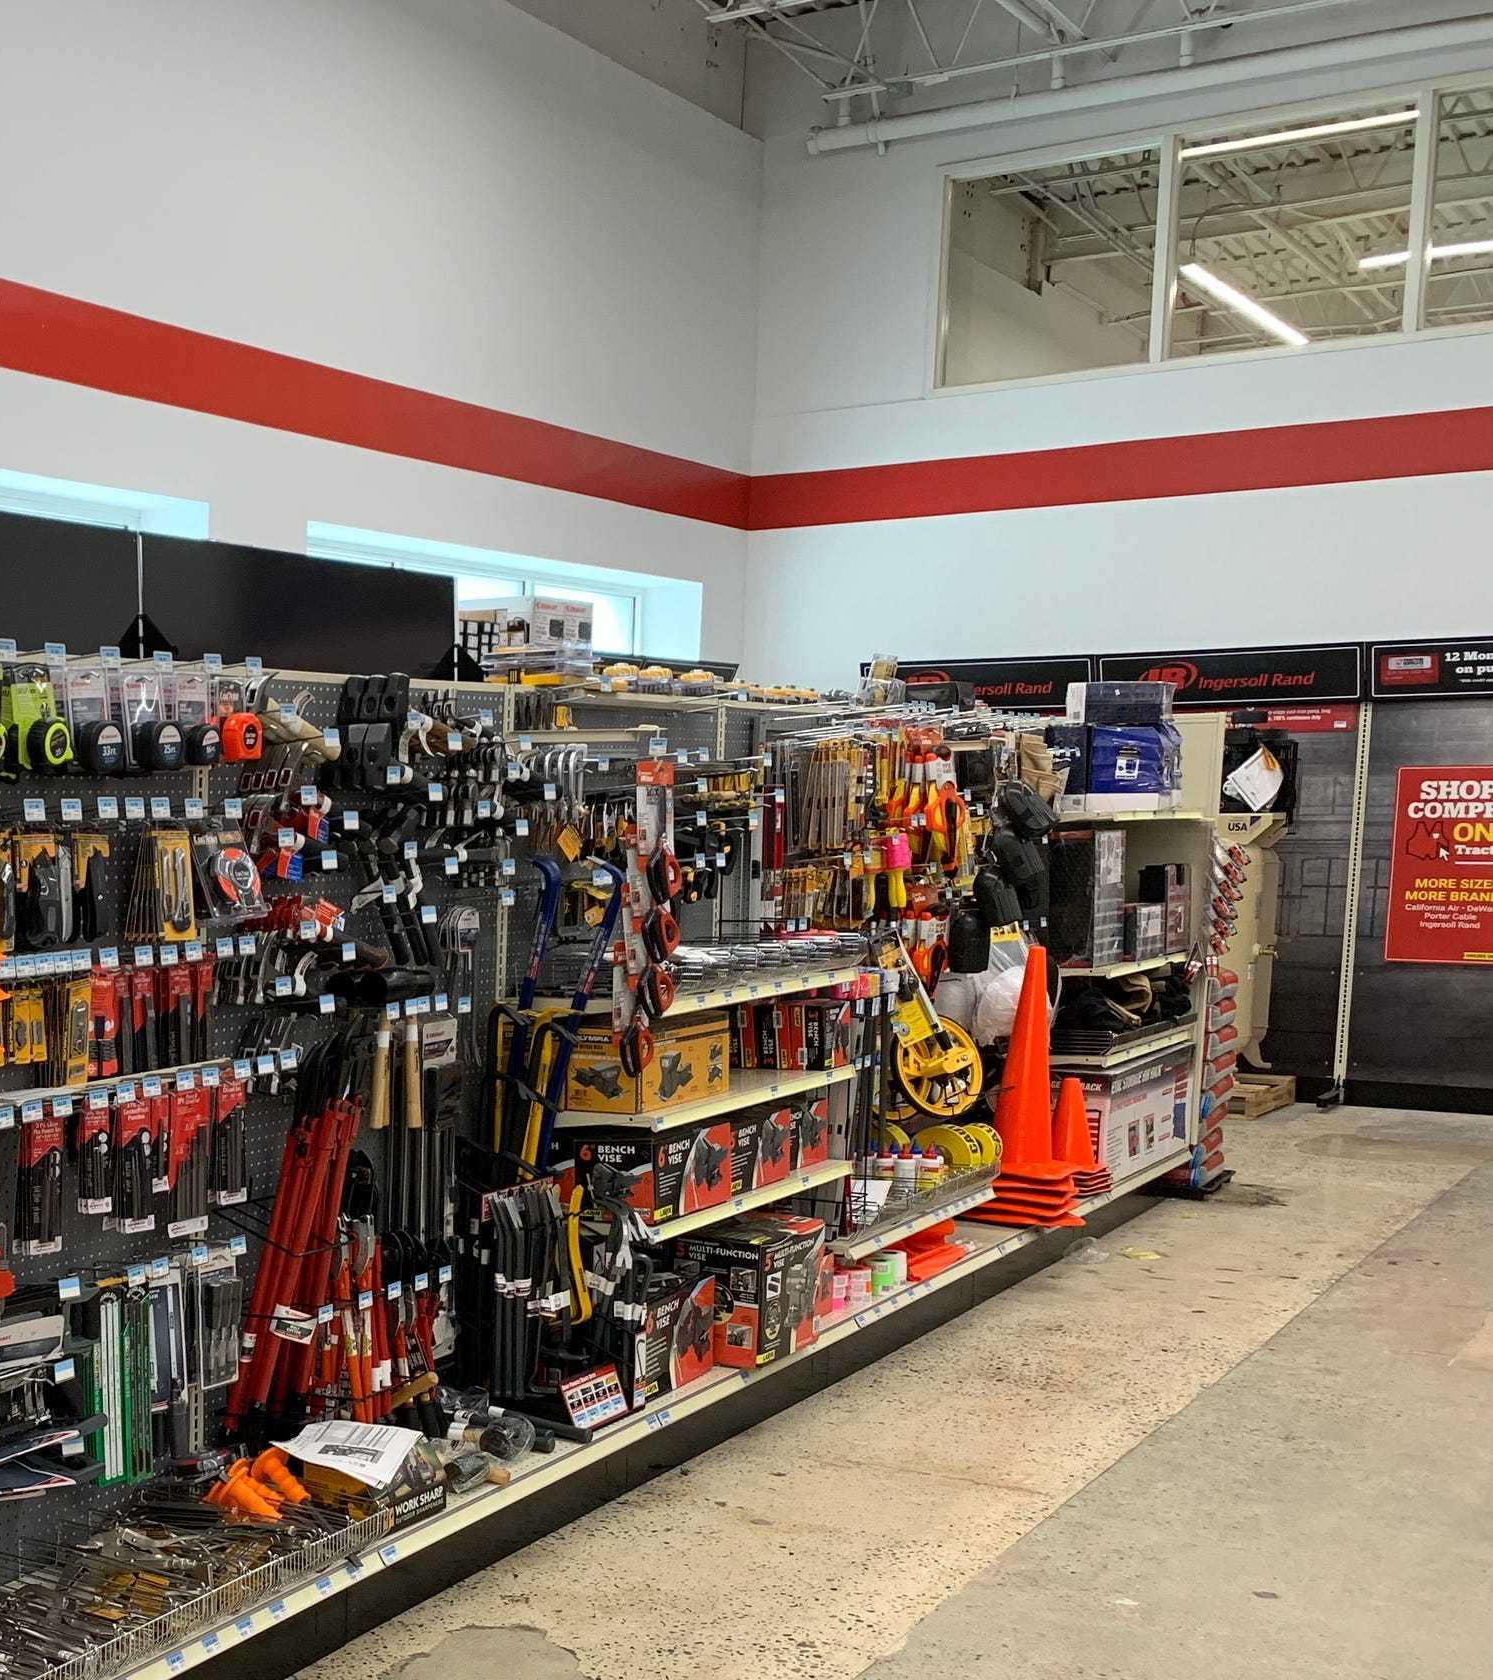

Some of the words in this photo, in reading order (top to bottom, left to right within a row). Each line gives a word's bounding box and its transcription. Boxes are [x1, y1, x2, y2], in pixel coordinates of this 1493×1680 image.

[1444, 652, 1461, 662] 12
[1455, 665, 1474, 674] on
[1198, 674, 1270, 691] Ingersoll
[1271, 671, 1316, 687] Rand
[974, 681, 1012, 696] ersoll
[1014, 681, 1054, 695] Rand
[1228, 822, 1248, 832] USA
[1414, 878, 1457, 889] MORE
[1460, 878, 1493, 889] SIZE
[1405, 891, 1447, 901] MORE
[1405, 903, 1451, 912] California
[1452, 903, 1460, 912] Air
[1424, 912, 1450, 920] Porter
[1452, 912, 1478, 921] Cable
[1419, 920, 1456, 930] Ingersoll
[1457, 920, 1481, 929] Rand
[738, 1124, 757, 1139] BENCH
[668, 1138, 691, 1155] BENCH
[737, 1136, 750, 1147] VISE
[597, 1145, 636, 1155] BENCH
[597, 1154, 623, 1163] VISE
[668, 1153, 683, 1165] VISE
[689, 1244, 759, 1260] MULTI-FUNCTION
[689, 1252, 707, 1262] VISE
[774, 1258, 785, 1269] VISE
[657, 1298, 680, 1318] BENCH
[656, 1315, 671, 1330] VISE
[395, 1496, 420, 1516] WORK
[419, 1485, 444, 1506] SHARP
